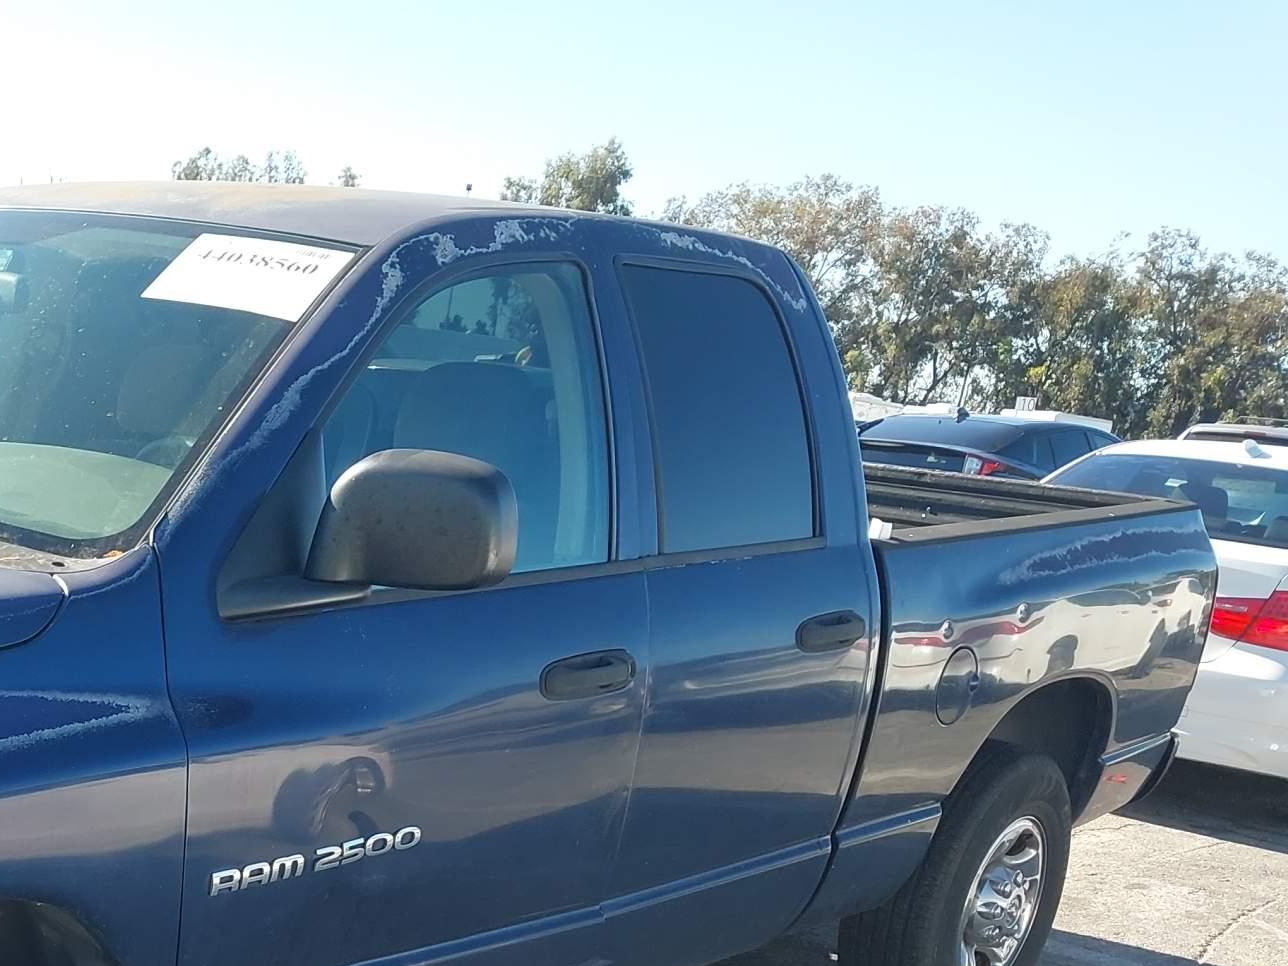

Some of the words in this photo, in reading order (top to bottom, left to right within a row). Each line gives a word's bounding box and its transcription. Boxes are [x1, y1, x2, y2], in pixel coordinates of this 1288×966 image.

[198, 248, 319, 275] 44038560
[209, 853, 305, 897] RAM
[314, 825, 422, 872] 2500
